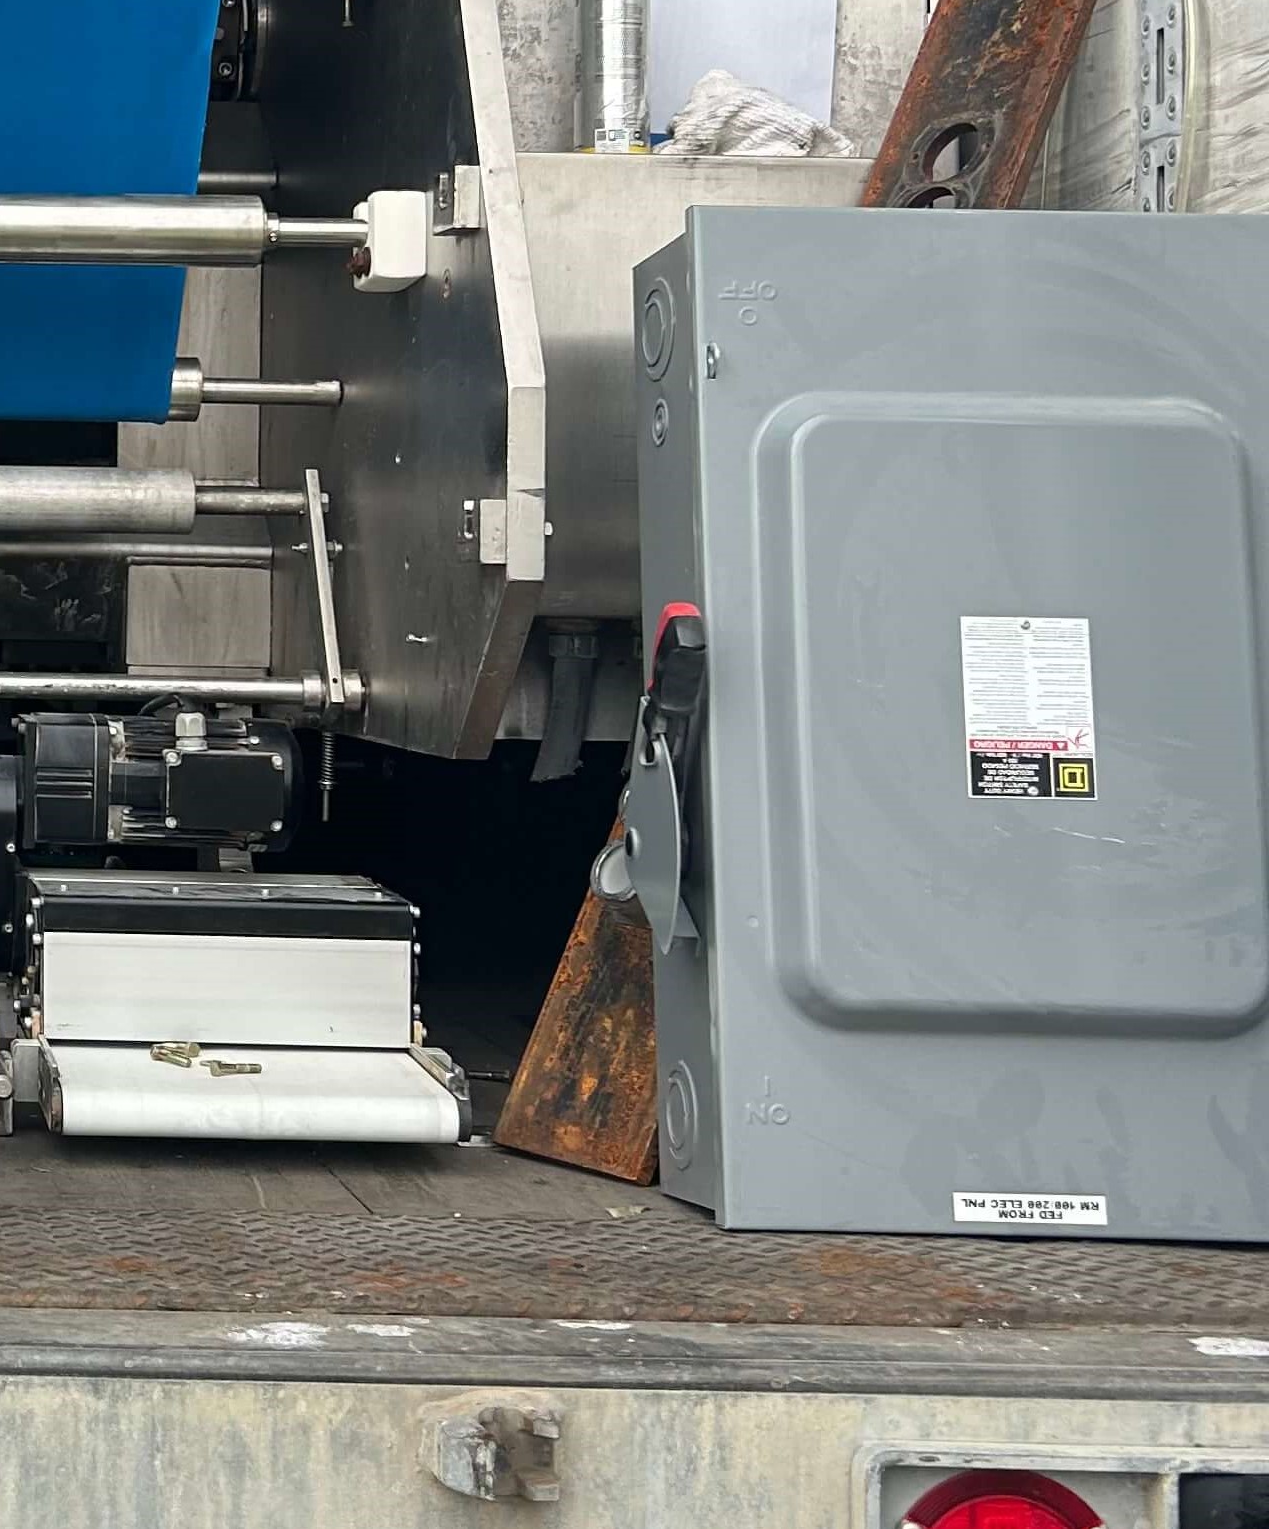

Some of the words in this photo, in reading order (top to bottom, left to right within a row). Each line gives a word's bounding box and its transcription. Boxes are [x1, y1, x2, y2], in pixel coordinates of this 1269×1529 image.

[717, 280, 777, 302] OFF
[1017, 741, 1053, 750] DANGER
[961, 1198, 986, 1208] PNL
[991, 1199, 1023, 1209] ELEC
[1080, 1201, 1100, 1211] RM
[998, 1208, 1035, 1219] FROM
[1039, 1209, 1063, 1220] FED
